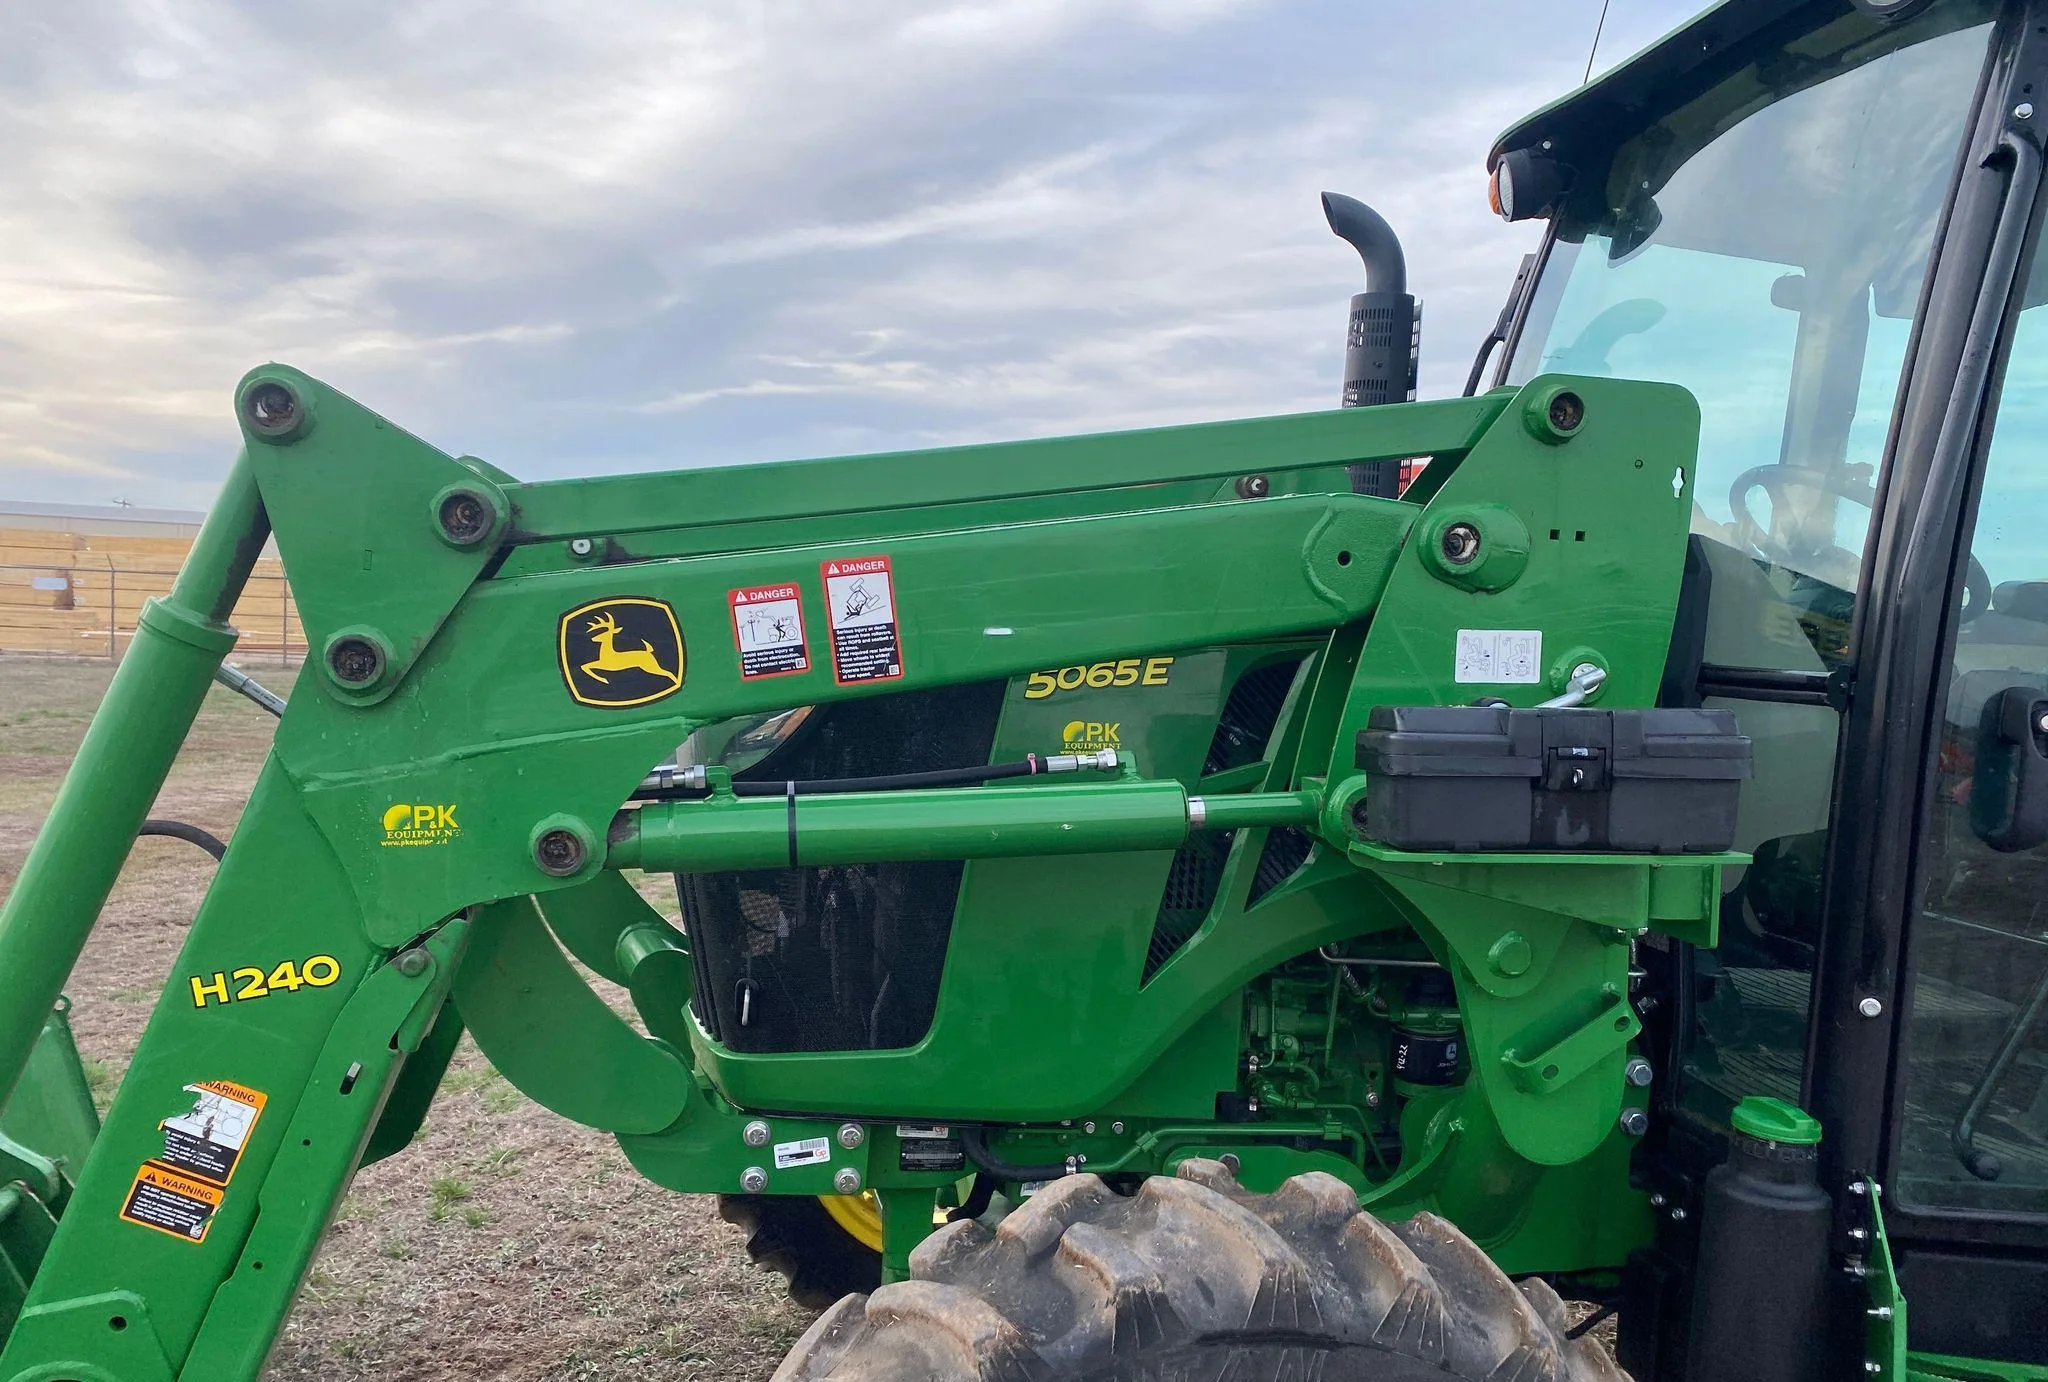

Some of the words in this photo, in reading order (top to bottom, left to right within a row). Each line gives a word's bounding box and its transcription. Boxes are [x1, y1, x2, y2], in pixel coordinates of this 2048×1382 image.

[842, 561, 885, 572] DANGER
[750, 588, 794, 600] DANGER
[1024, 657, 1174, 699] 5065E
[1065, 742, 1121, 750] EQUIPMENT
[189, 954, 342, 1009] H240
[205, 1081, 256, 1103] WARNING
[162, 1176, 213, 1200] WARNING
